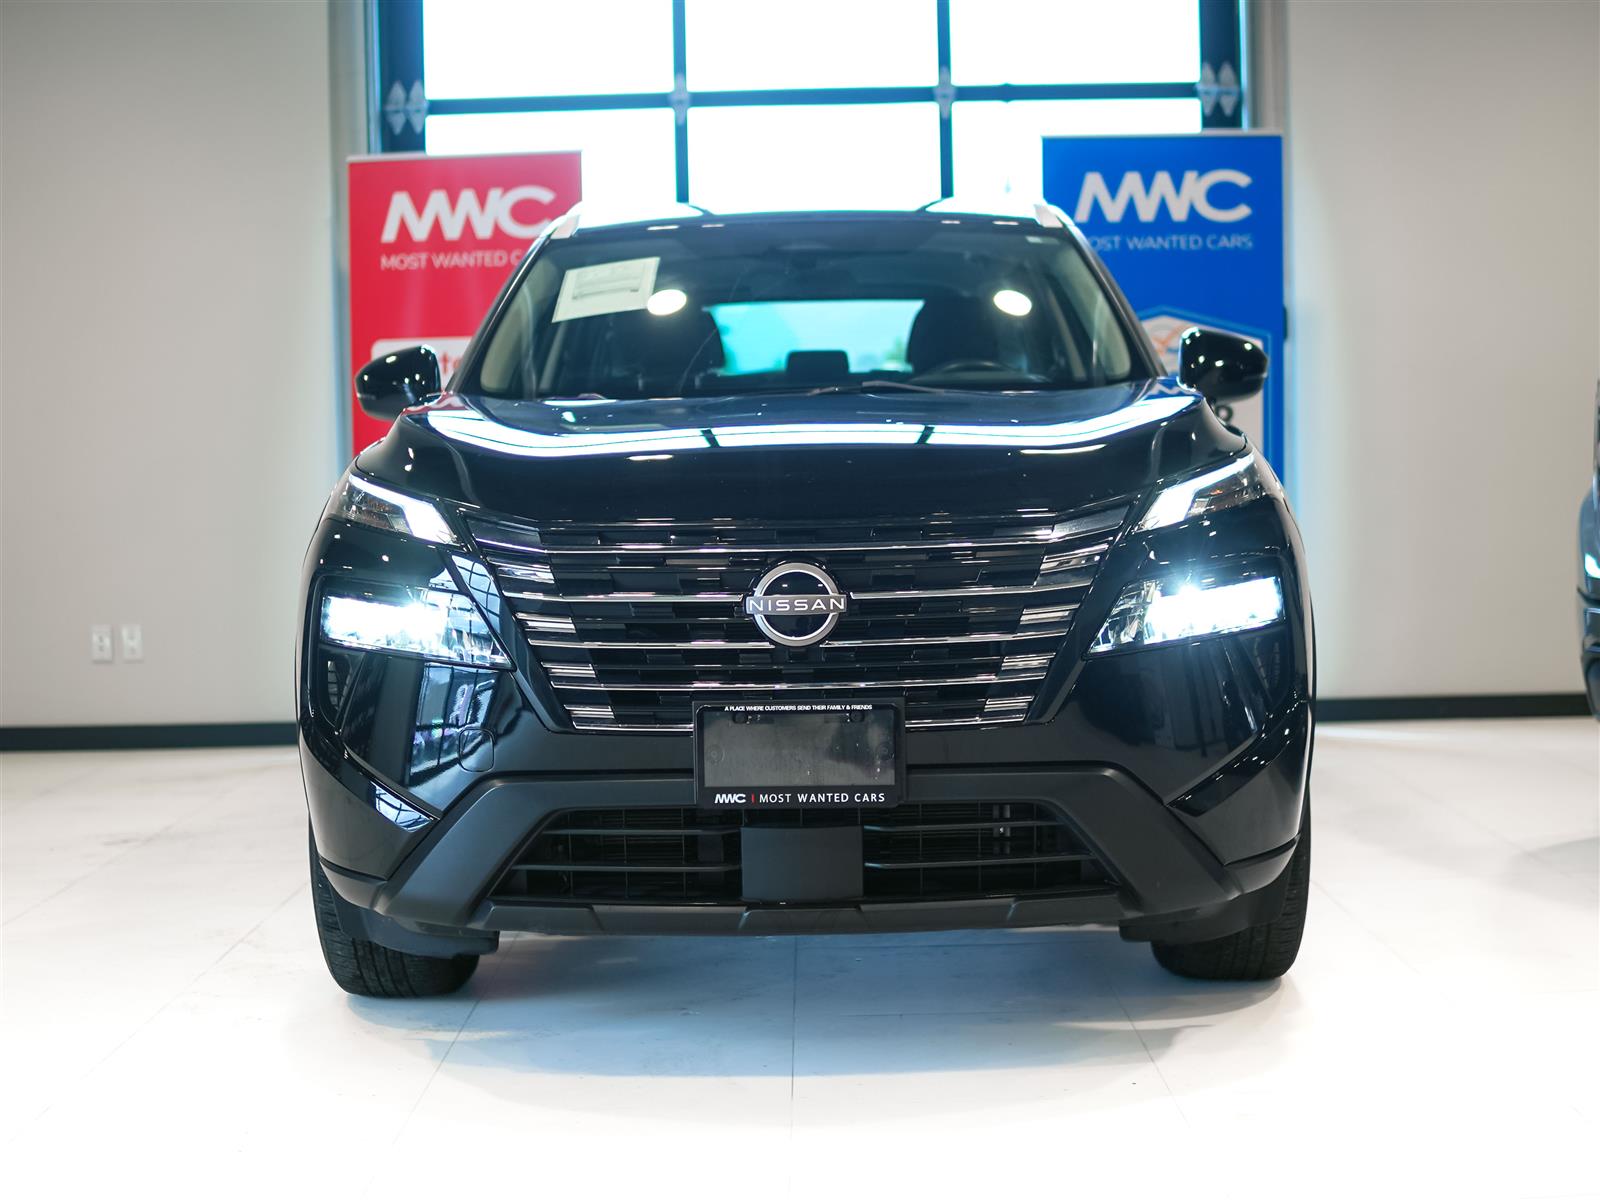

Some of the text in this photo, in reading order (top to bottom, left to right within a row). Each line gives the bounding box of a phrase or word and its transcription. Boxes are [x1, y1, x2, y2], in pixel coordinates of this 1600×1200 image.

[1074, 169, 1252, 222] MWC
[381, 185, 556, 243] MWC
[1087, 232, 1253, 251] OST WANTED CARS
[381, 254, 427, 270] MOST
[432, 251, 507, 268] WANTED
[749, 598, 844, 611] NISSAN
[715, 793, 885, 804] MWC MOST WANTED CARS
